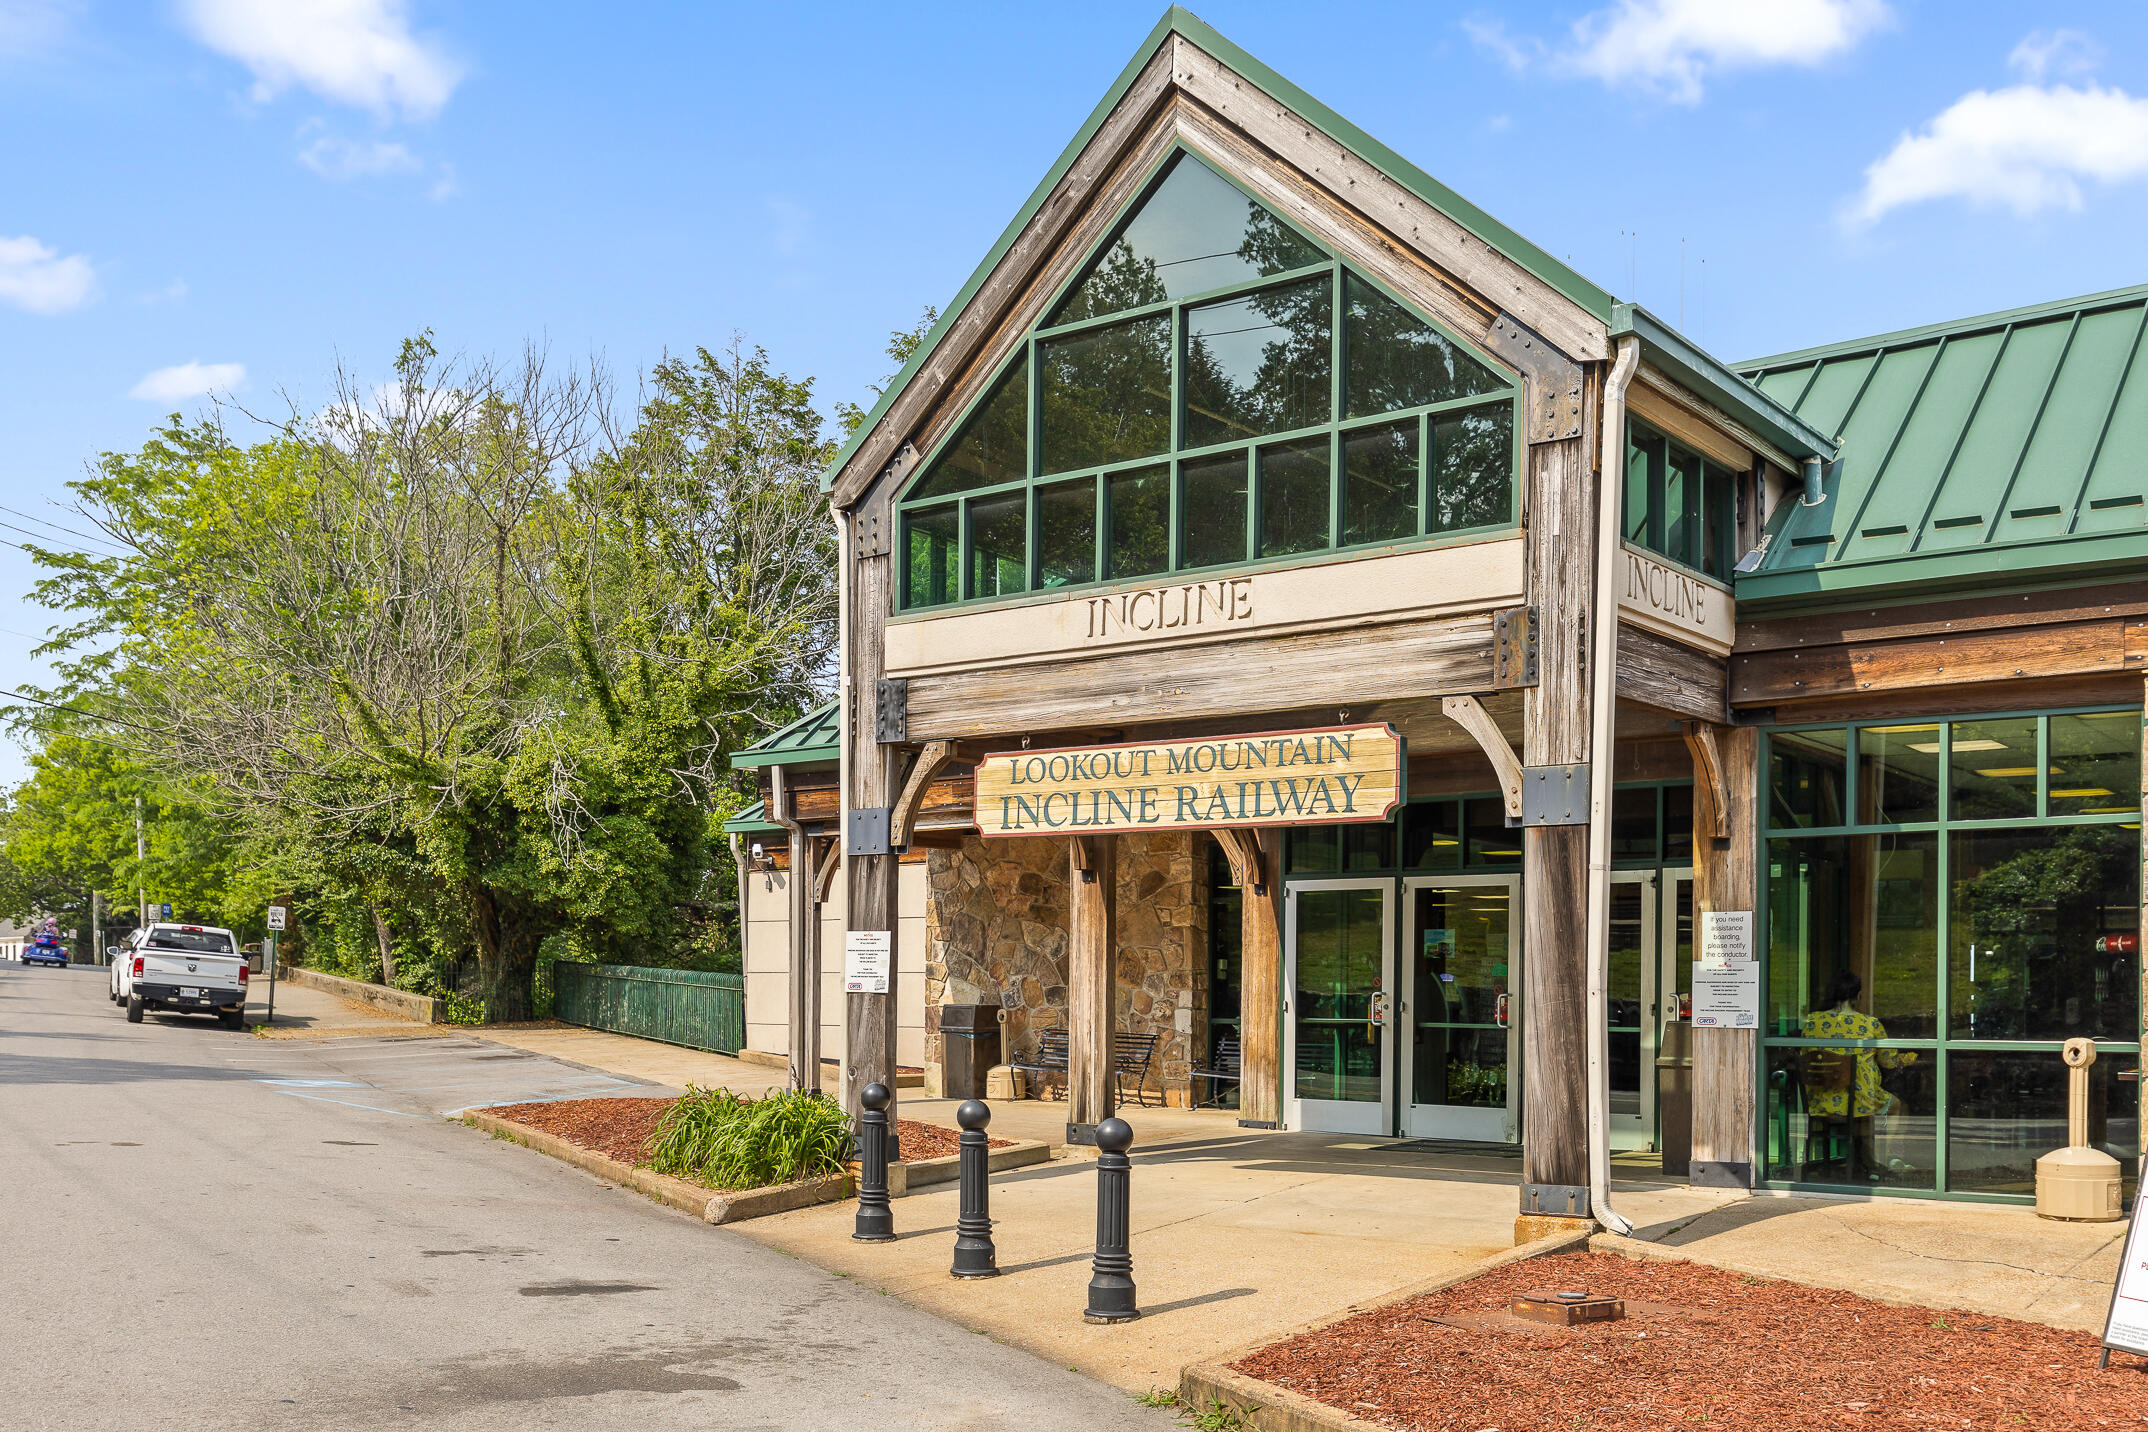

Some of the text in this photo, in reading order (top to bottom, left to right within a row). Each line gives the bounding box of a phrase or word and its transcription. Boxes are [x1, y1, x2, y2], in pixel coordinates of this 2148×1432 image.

[1087, 577, 1252, 638] INCLINE
[1627, 554, 1706, 625] INCLINE
[1010, 733, 1355, 785] LOOKOUT MOUNTAIN
[1000, 774, 1365, 830] INCLINE RAILWAY
[1715, 916, 1727, 924] you
[1729, 942, 1746, 950] notify
